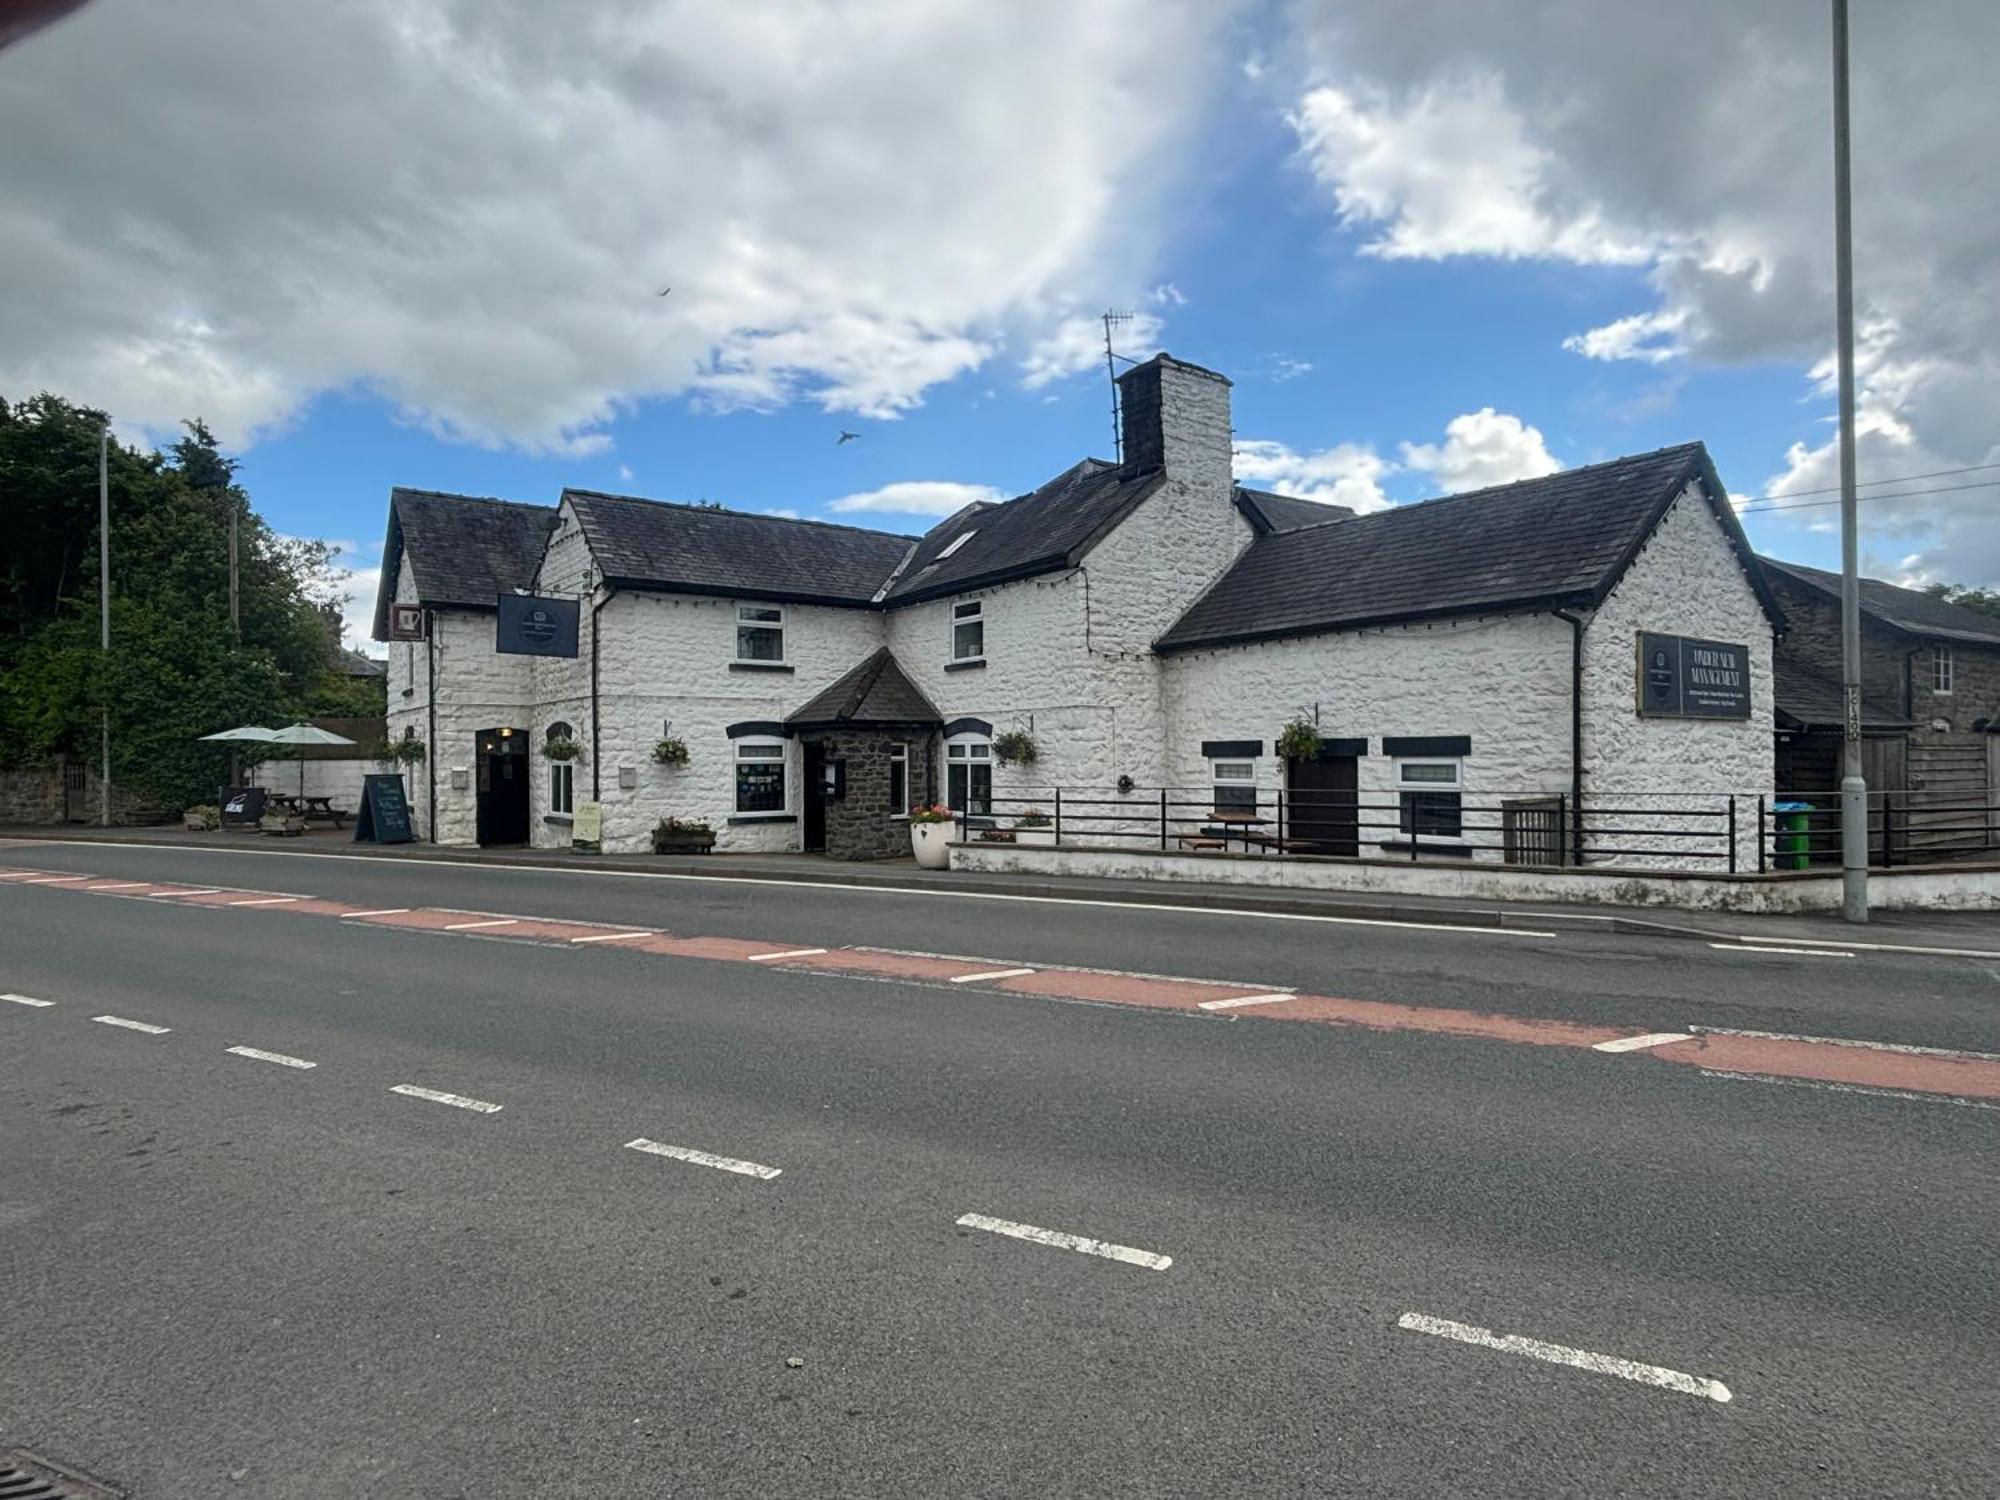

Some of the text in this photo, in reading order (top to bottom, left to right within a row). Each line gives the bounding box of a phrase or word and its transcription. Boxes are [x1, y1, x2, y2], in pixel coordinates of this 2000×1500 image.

[1694, 649, 1735, 668] UNDER NEW
[1691, 667, 1740, 686] MANAGEMENT
